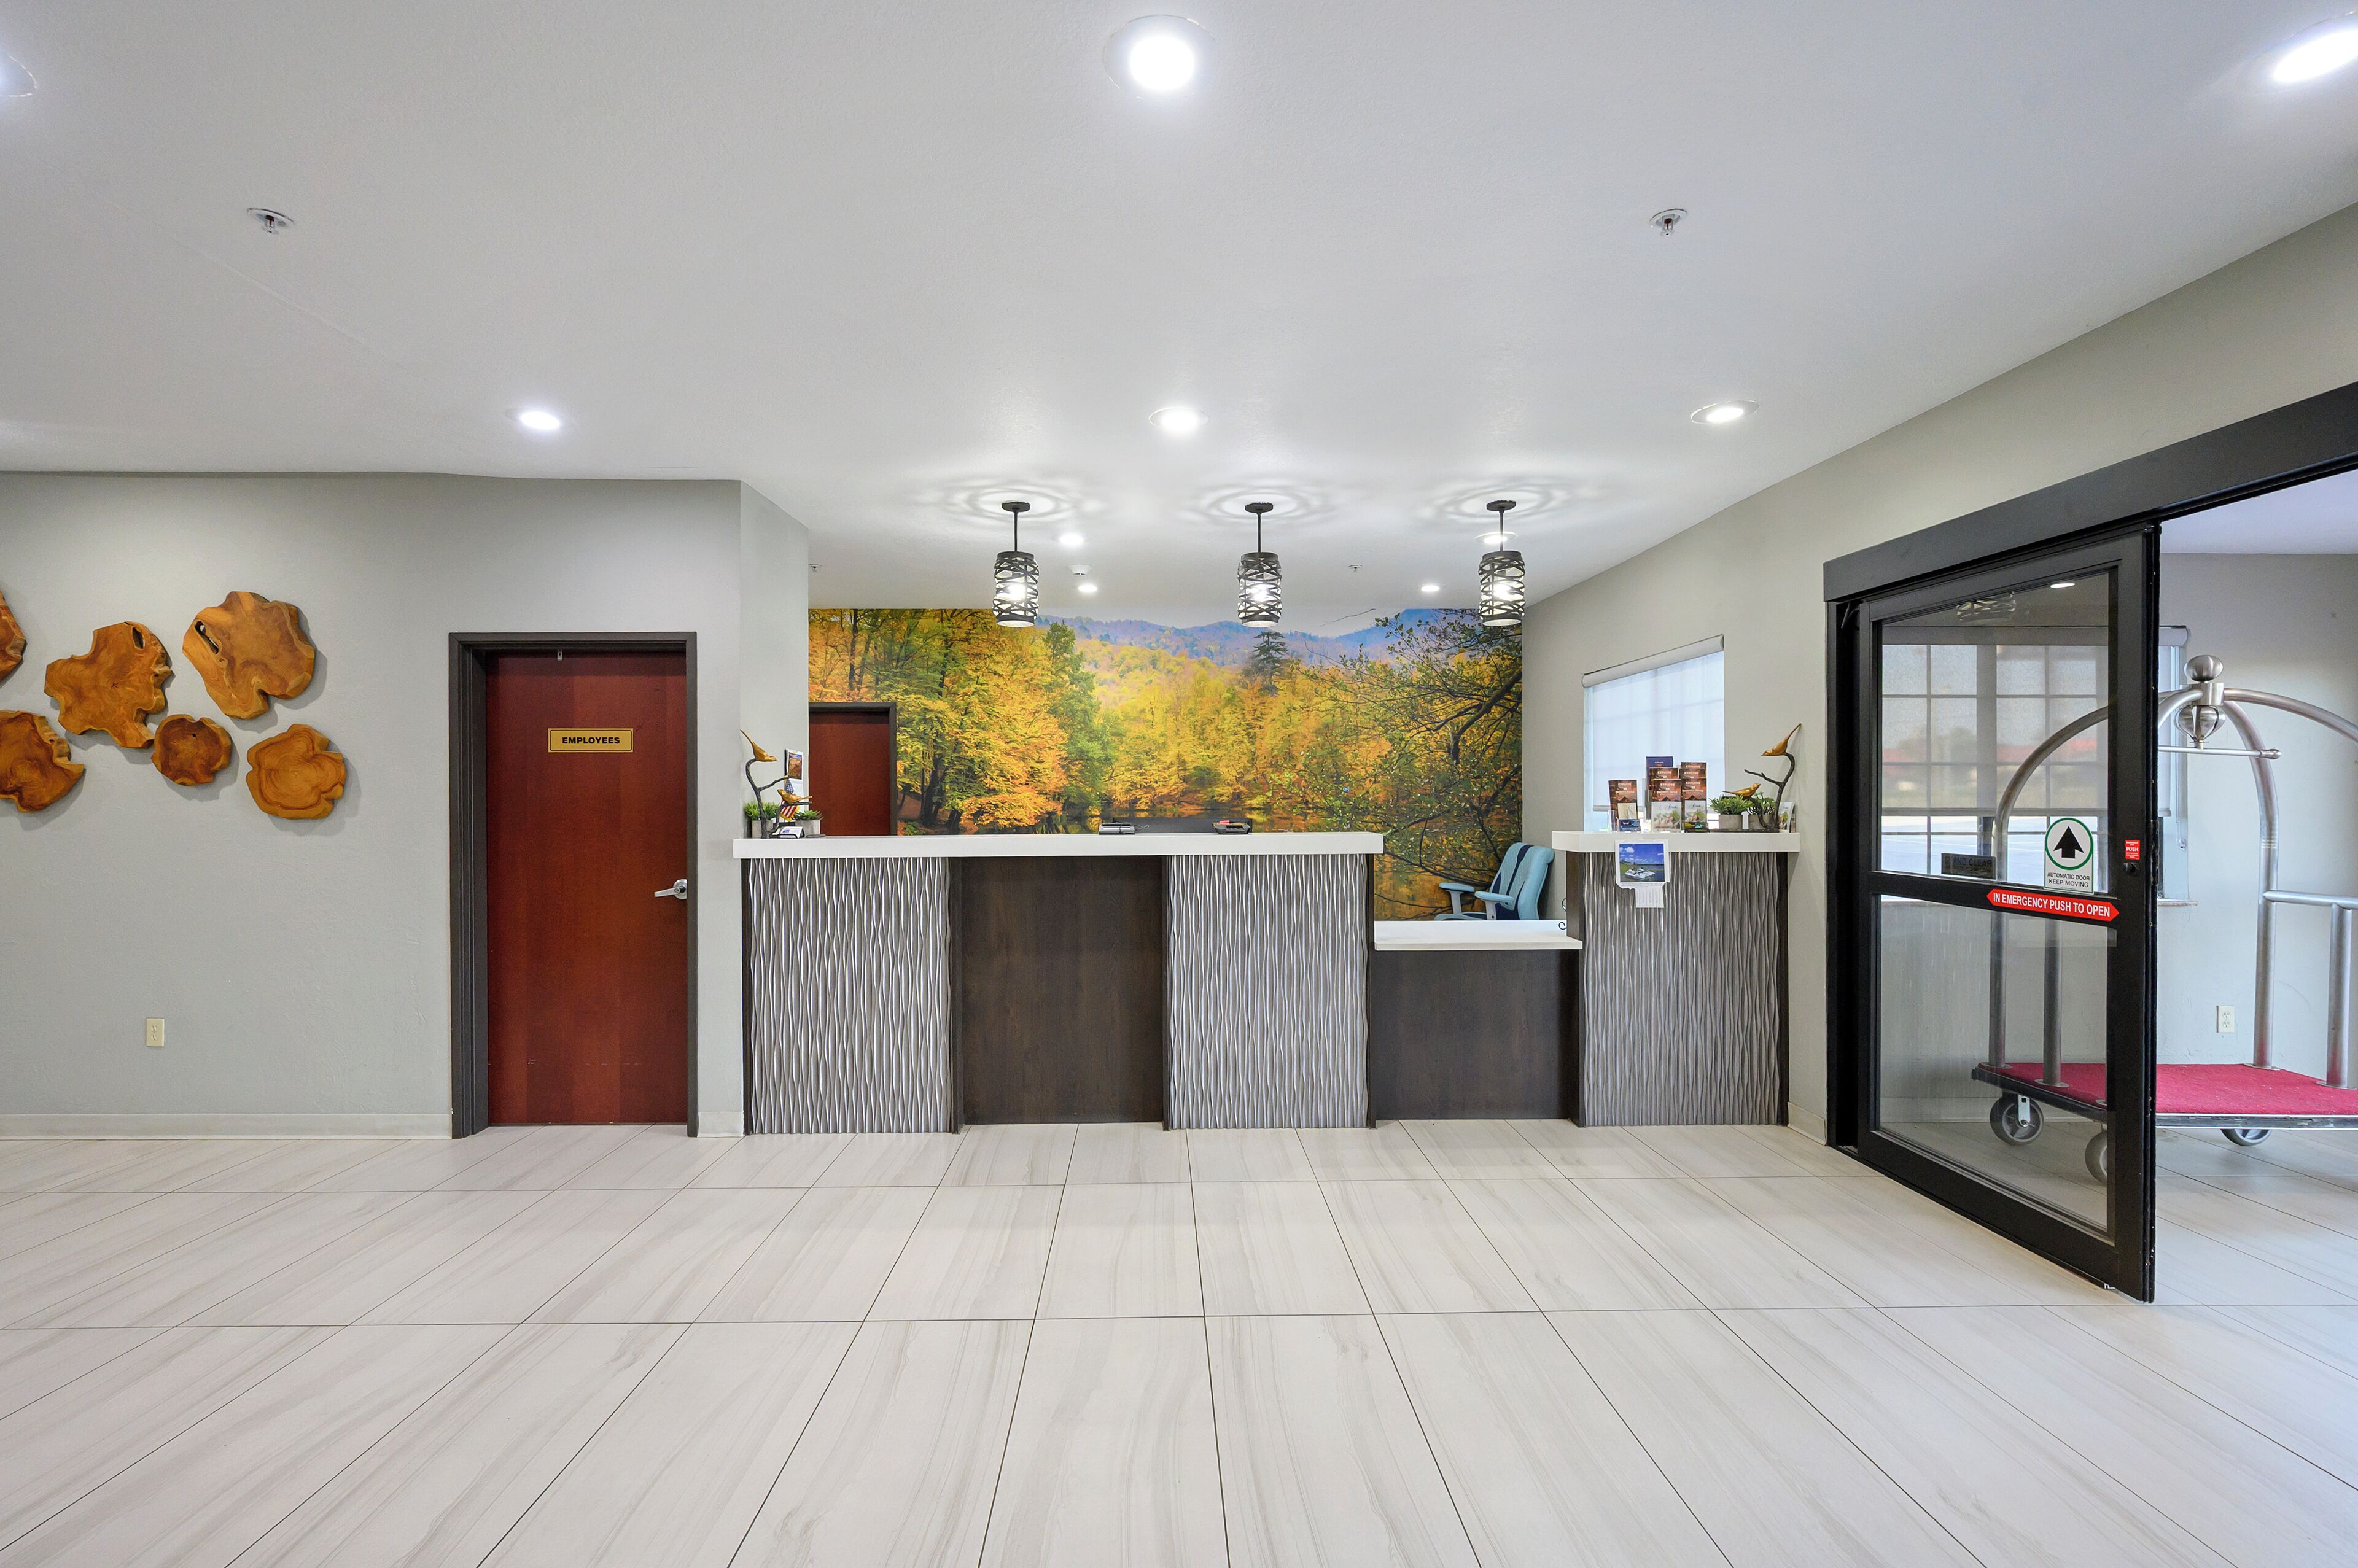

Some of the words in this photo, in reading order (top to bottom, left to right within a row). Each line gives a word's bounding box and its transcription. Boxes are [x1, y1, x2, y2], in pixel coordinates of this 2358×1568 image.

[1945, 856, 1967, 865] SAND
[1968, 858, 1992, 867] CLEAR
[1993, 893, 2001, 902] IN
[2002, 893, 2048, 909] EMERGENCY
[2049, 899, 2071, 912] PUSH
[2073, 902, 2084, 914] TO
[2086, 904, 2111, 917] OPEN
